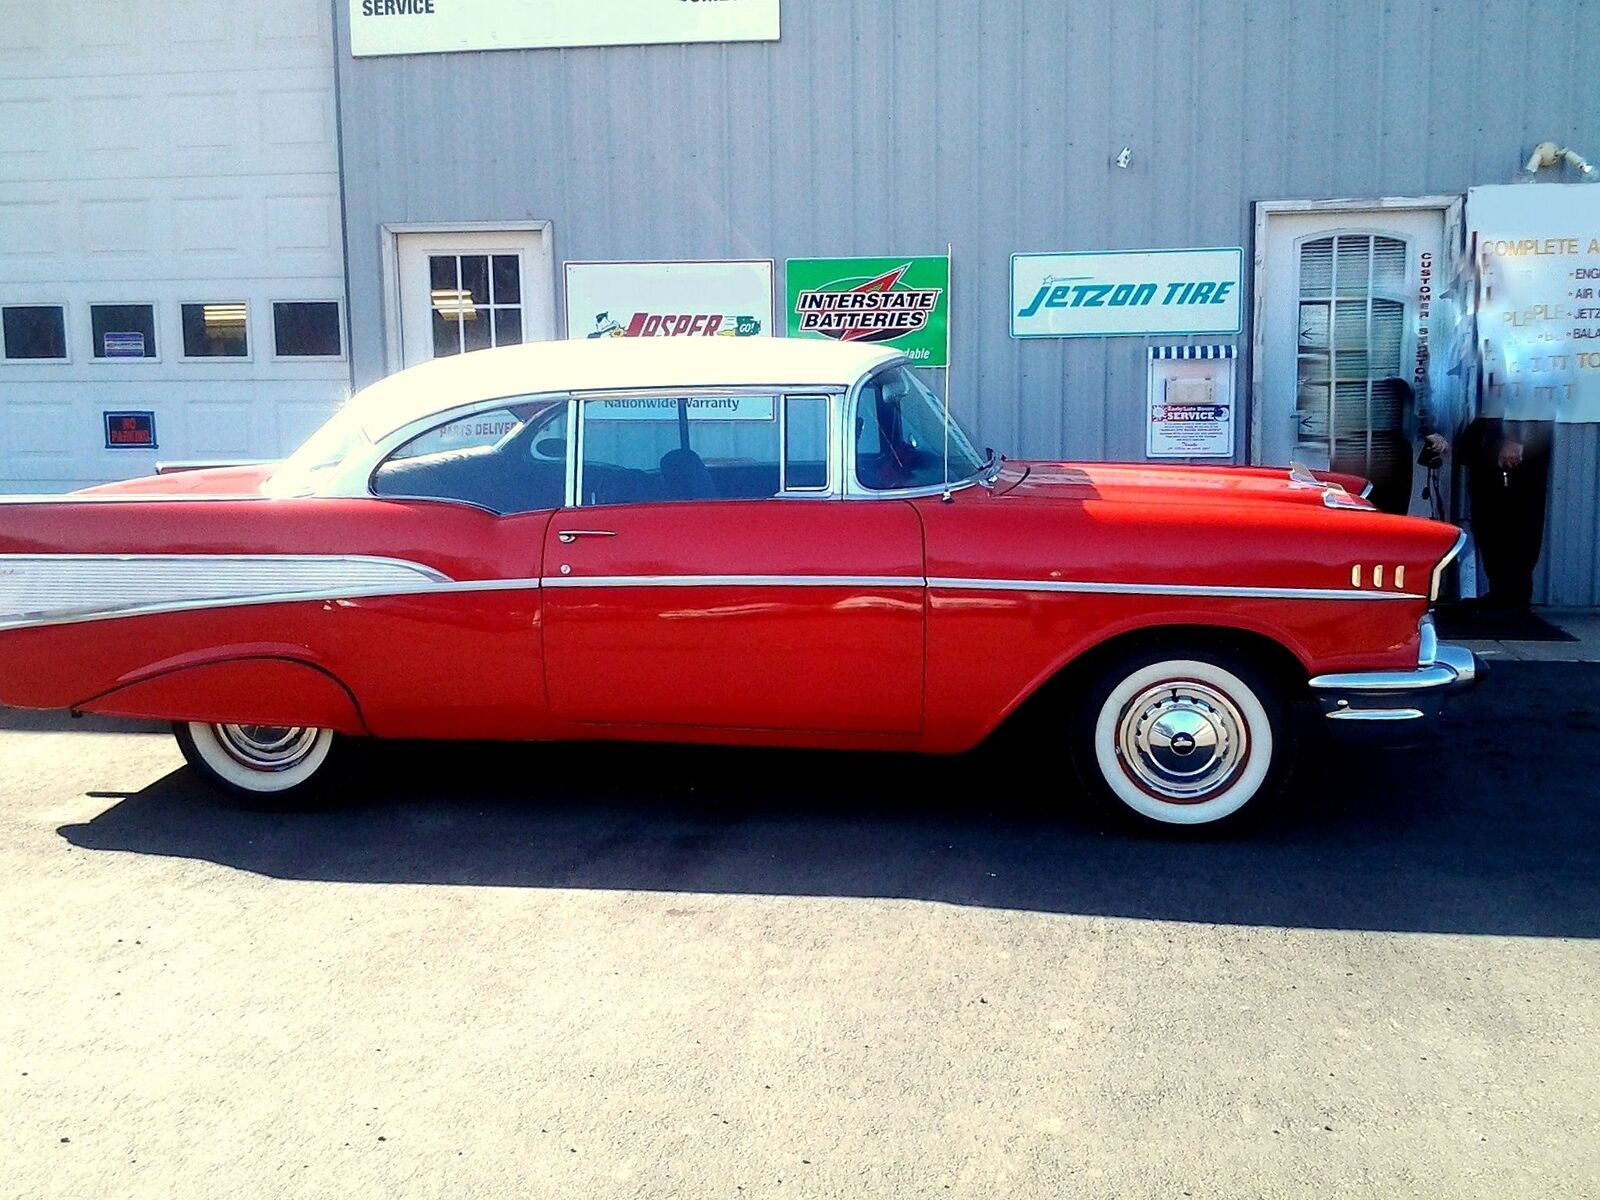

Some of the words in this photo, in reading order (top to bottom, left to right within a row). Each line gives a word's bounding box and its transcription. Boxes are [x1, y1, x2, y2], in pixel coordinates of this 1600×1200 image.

[362, 0, 435, 16] SERVICE
[1482, 238, 1579, 256] COMPLETE
[1162, 281, 1235, 305] TIRE
[1418, 252, 1432, 321] CUSTOMER
[1575, 288, 1593, 299] AIR
[800, 293, 933, 309] INTERSTATE
[804, 311, 924, 328] BATTERIES
[604, 398, 677, 409] Nationwide
[1167, 412, 1215, 420] SERVICE
